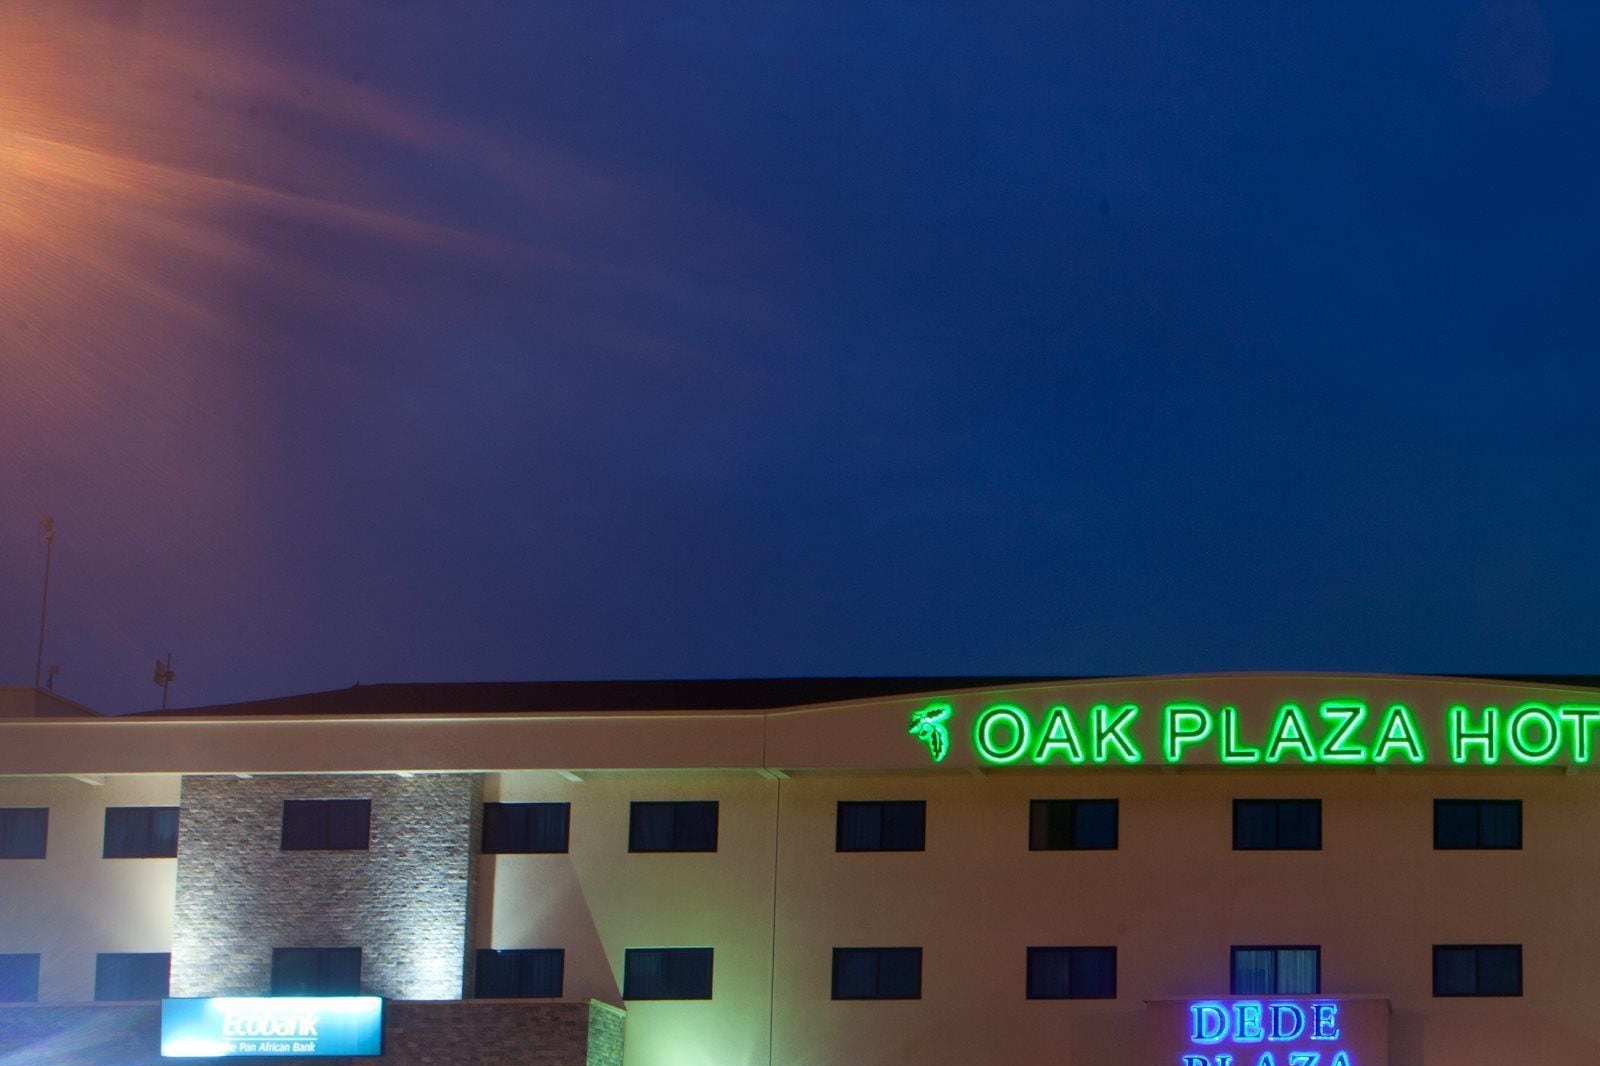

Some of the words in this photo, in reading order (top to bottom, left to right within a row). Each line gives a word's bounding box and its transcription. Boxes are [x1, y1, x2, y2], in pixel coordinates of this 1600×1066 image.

[978, 704, 1139, 764] OAK
[1165, 702, 1423, 764] PLAZA
[222, 1011, 320, 1036] Ecobank
[1191, 1002, 1340, 1043] DEDE
[239, 1041, 257, 1052] Pan
[258, 1041, 291, 1053] African
[293, 1041, 316, 1053] Bank
